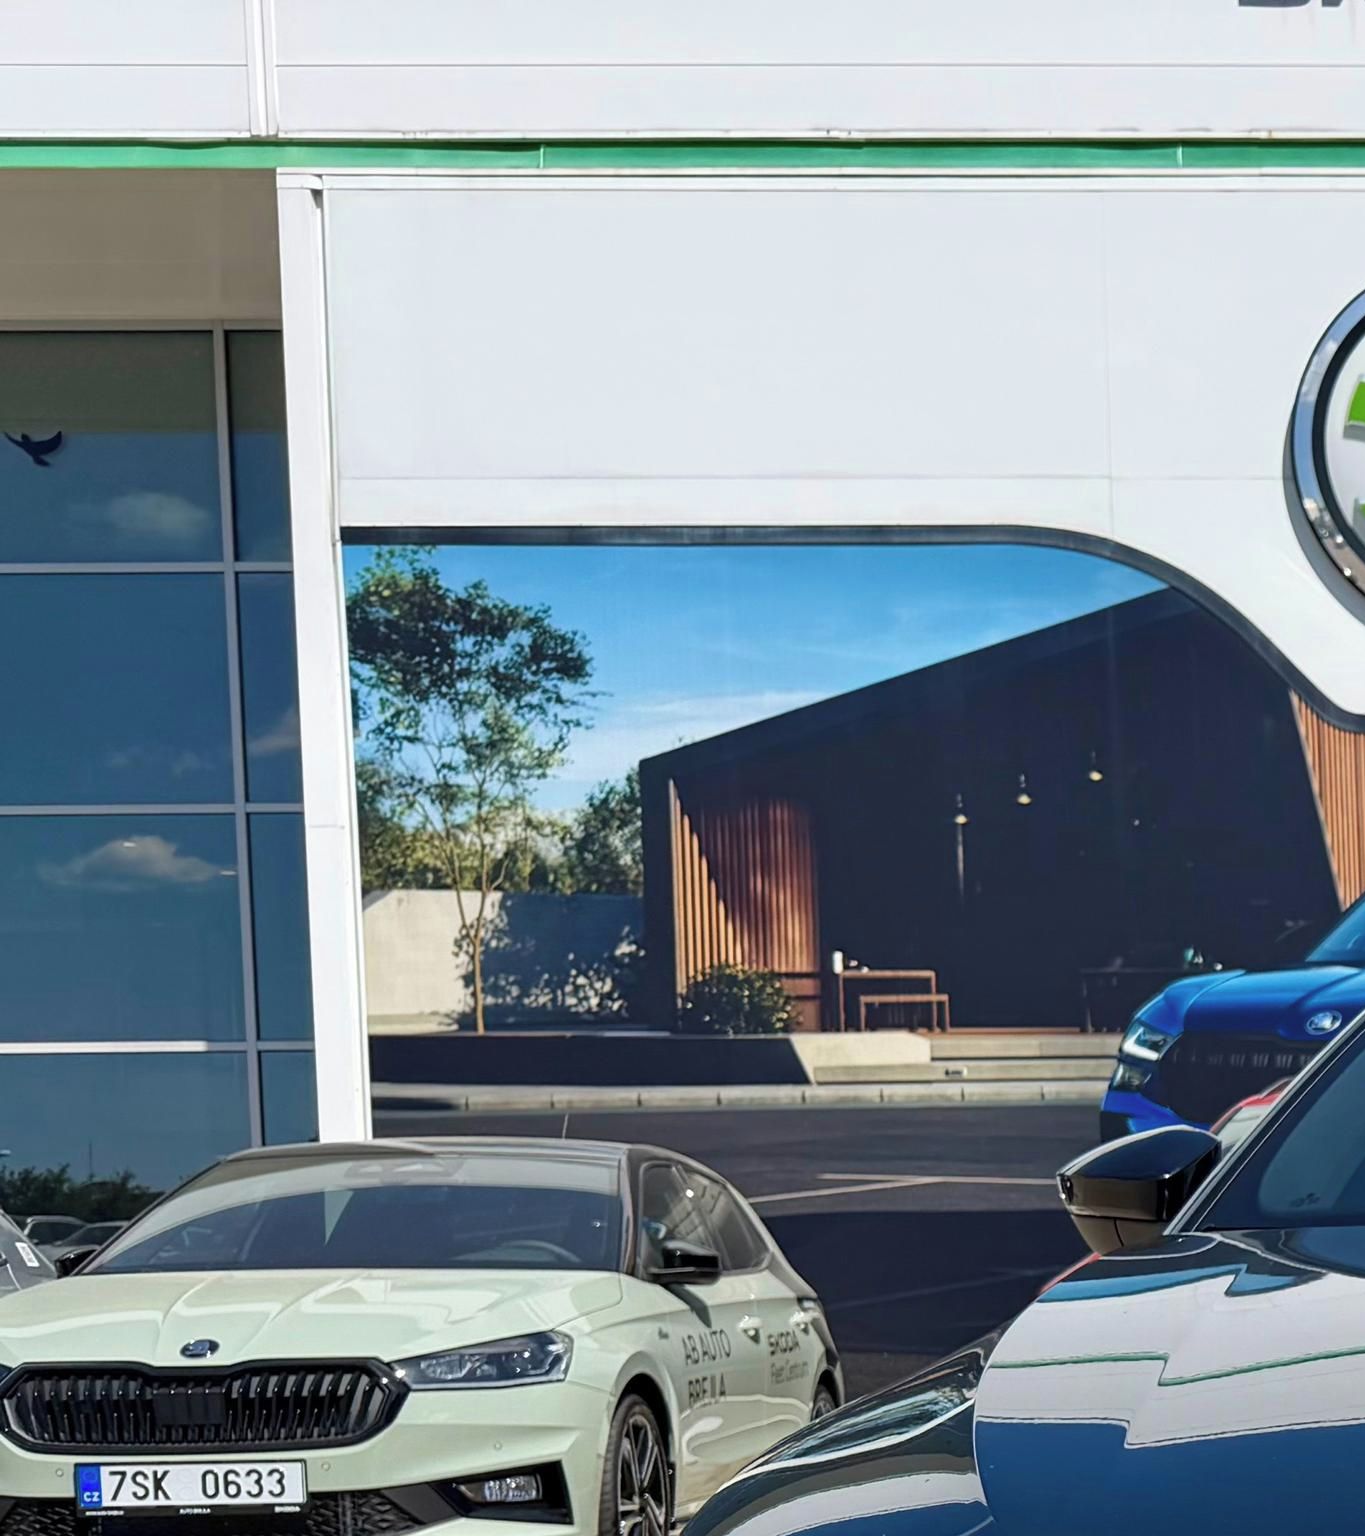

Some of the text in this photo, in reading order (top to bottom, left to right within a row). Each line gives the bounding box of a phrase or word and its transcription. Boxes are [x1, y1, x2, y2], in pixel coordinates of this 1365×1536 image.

[681, 1329, 732, 1366] AB AUTO
[83, 1491, 100, 1503] CZ
[108, 1469, 286, 1501] 7SK 0633
